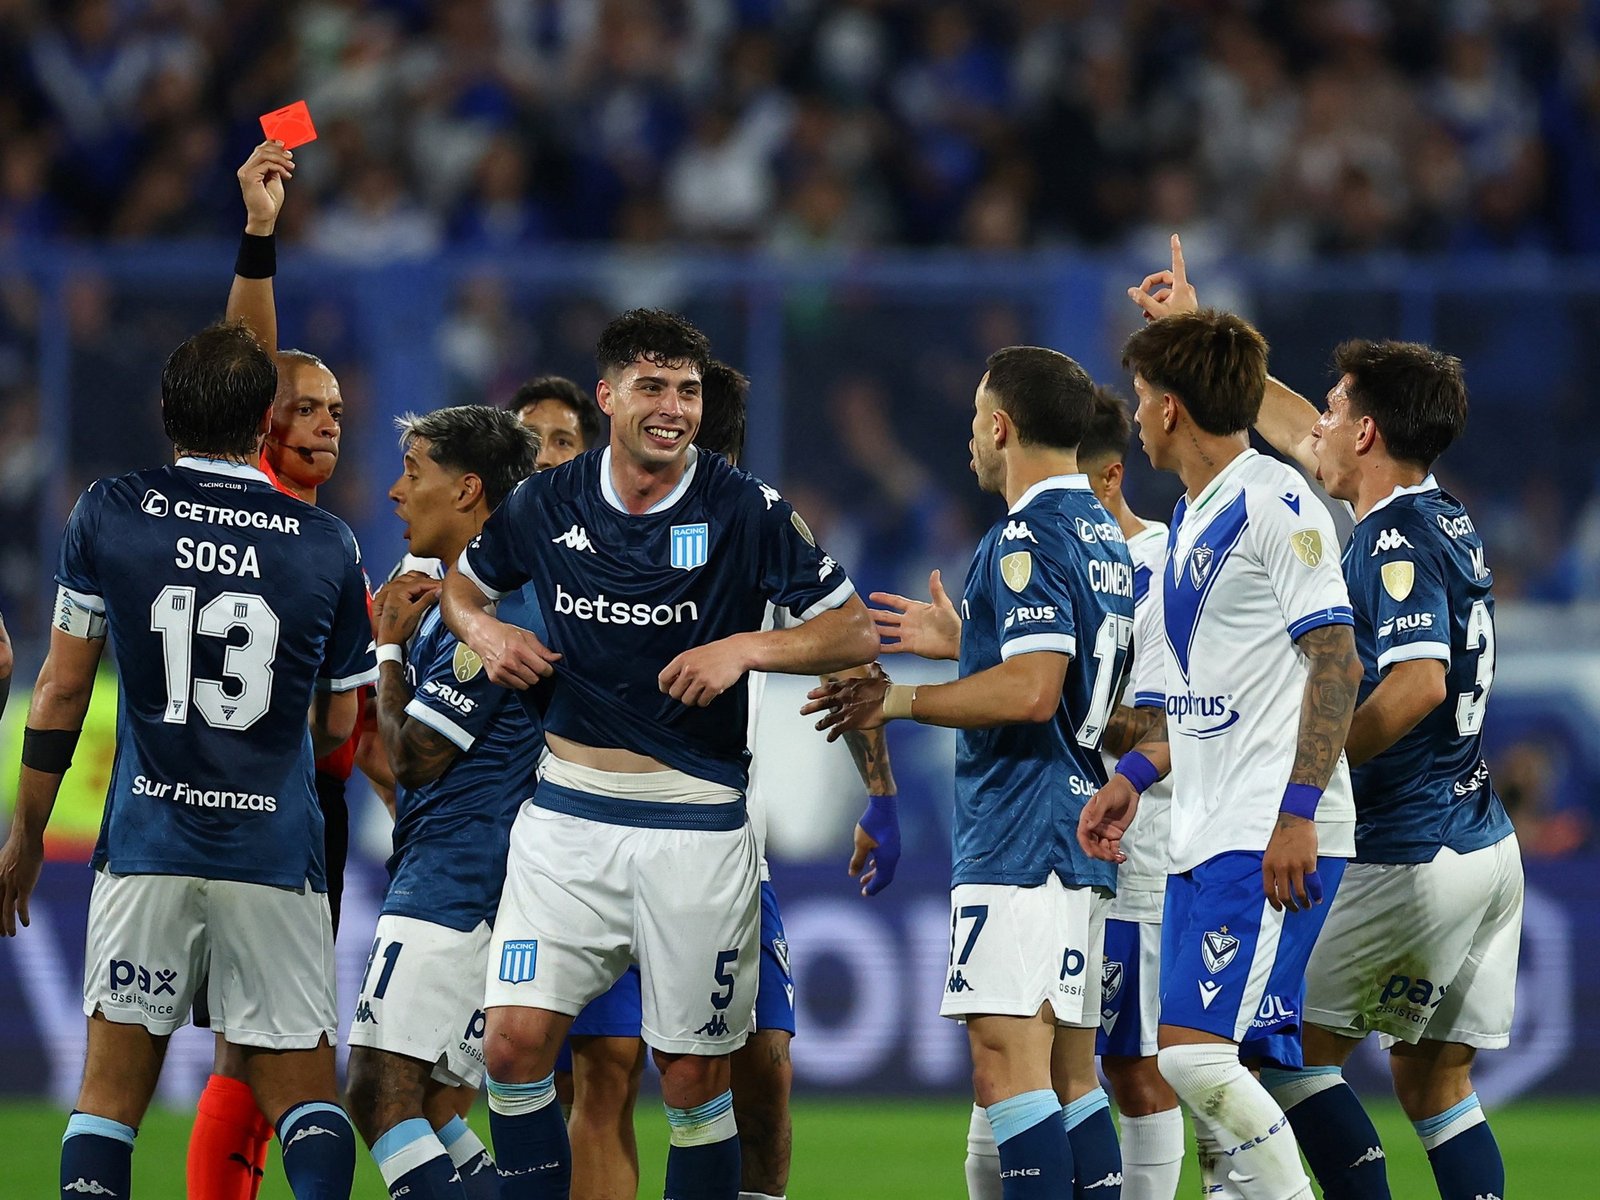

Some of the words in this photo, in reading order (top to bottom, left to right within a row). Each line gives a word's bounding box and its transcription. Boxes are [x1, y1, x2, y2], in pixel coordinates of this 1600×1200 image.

[174, 500, 301, 536] CETROGAR
[673, 525, 705, 536] RACING
[174, 537, 261, 579] SOSA
[554, 583, 699, 626] betsson
[1016, 605, 1056, 622] RUS
[1395, 612, 1434, 632] RUS
[150, 584, 281, 731] 13
[1455, 600, 1496, 737] 3
[437, 683, 476, 713] RUS
[131, 775, 172, 798] Sur
[173, 782, 277, 812] Finanzas
[504, 942, 535, 951] RACING
[109, 959, 178, 997] pax
[710, 947, 740, 1011] 5
